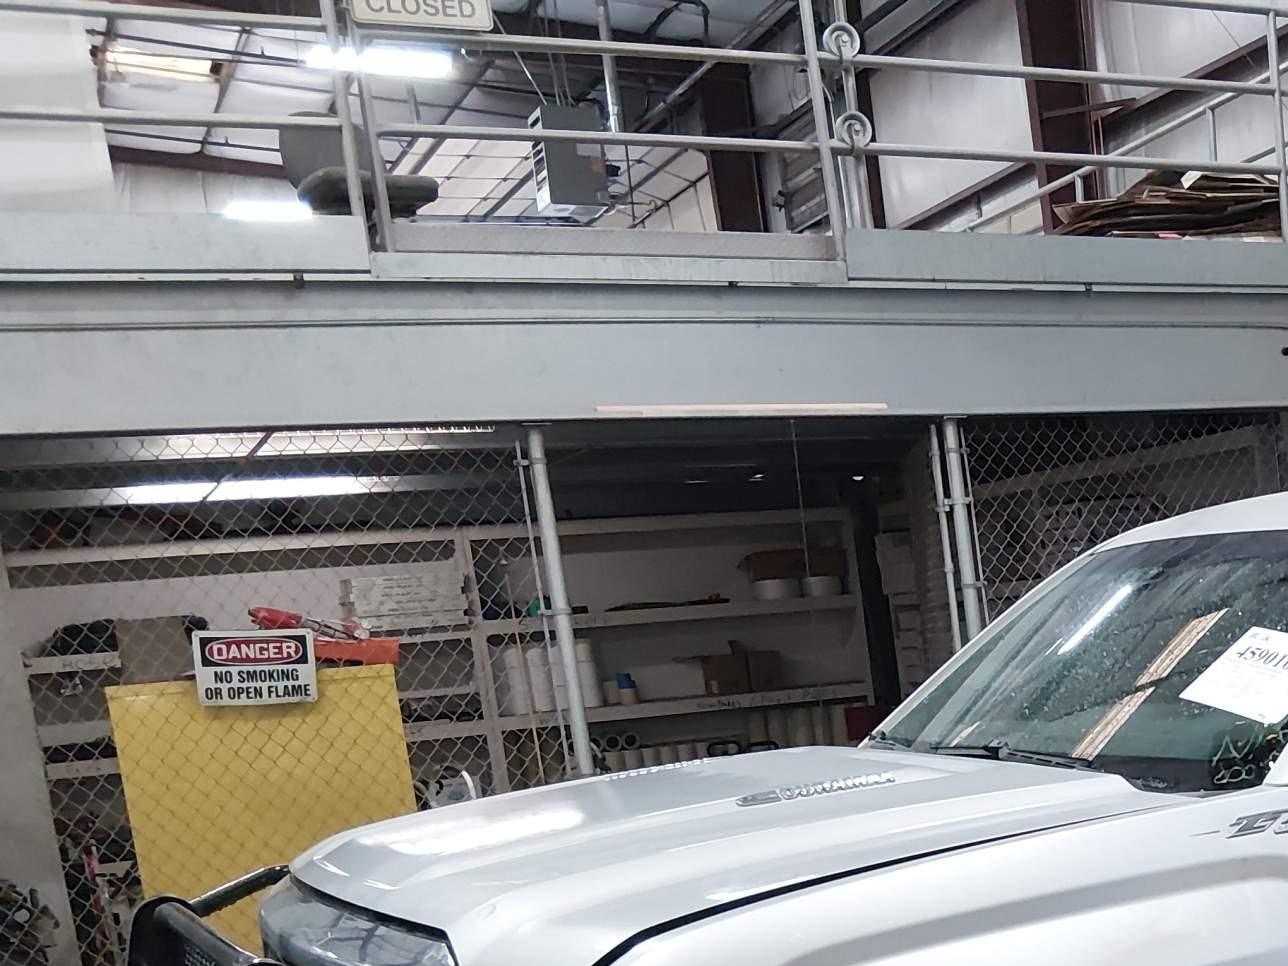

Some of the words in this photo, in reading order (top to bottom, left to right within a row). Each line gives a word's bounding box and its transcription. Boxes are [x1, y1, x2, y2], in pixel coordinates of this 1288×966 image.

[366, 0, 475, 18] CLOSED
[212, 641, 297, 660] DANGER
[213, 670, 232, 684] NO
[237, 668, 300, 684] SMOKING
[204, 686, 224, 700] OR
[228, 685, 263, 700] OPEN
[267, 683, 311, 698] FLAME
